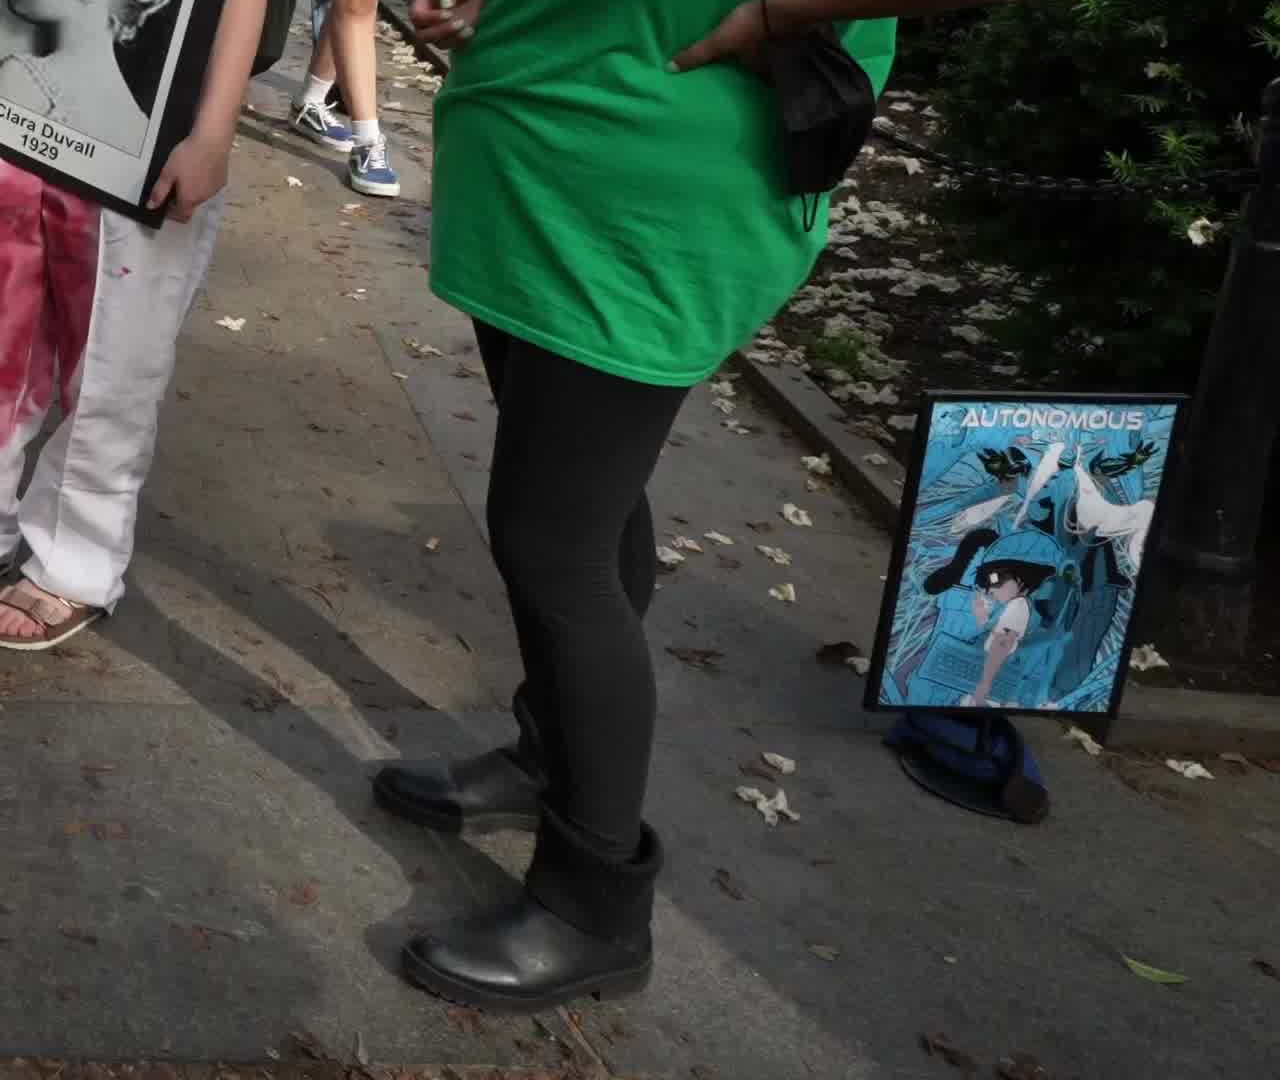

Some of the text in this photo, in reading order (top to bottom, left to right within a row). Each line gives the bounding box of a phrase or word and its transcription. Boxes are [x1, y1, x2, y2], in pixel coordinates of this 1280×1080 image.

[20, 133, 59, 161] 1929
[41, 123, 96, 159] Duvall
[960, 407, 1145, 431] AUTONOMOUS
